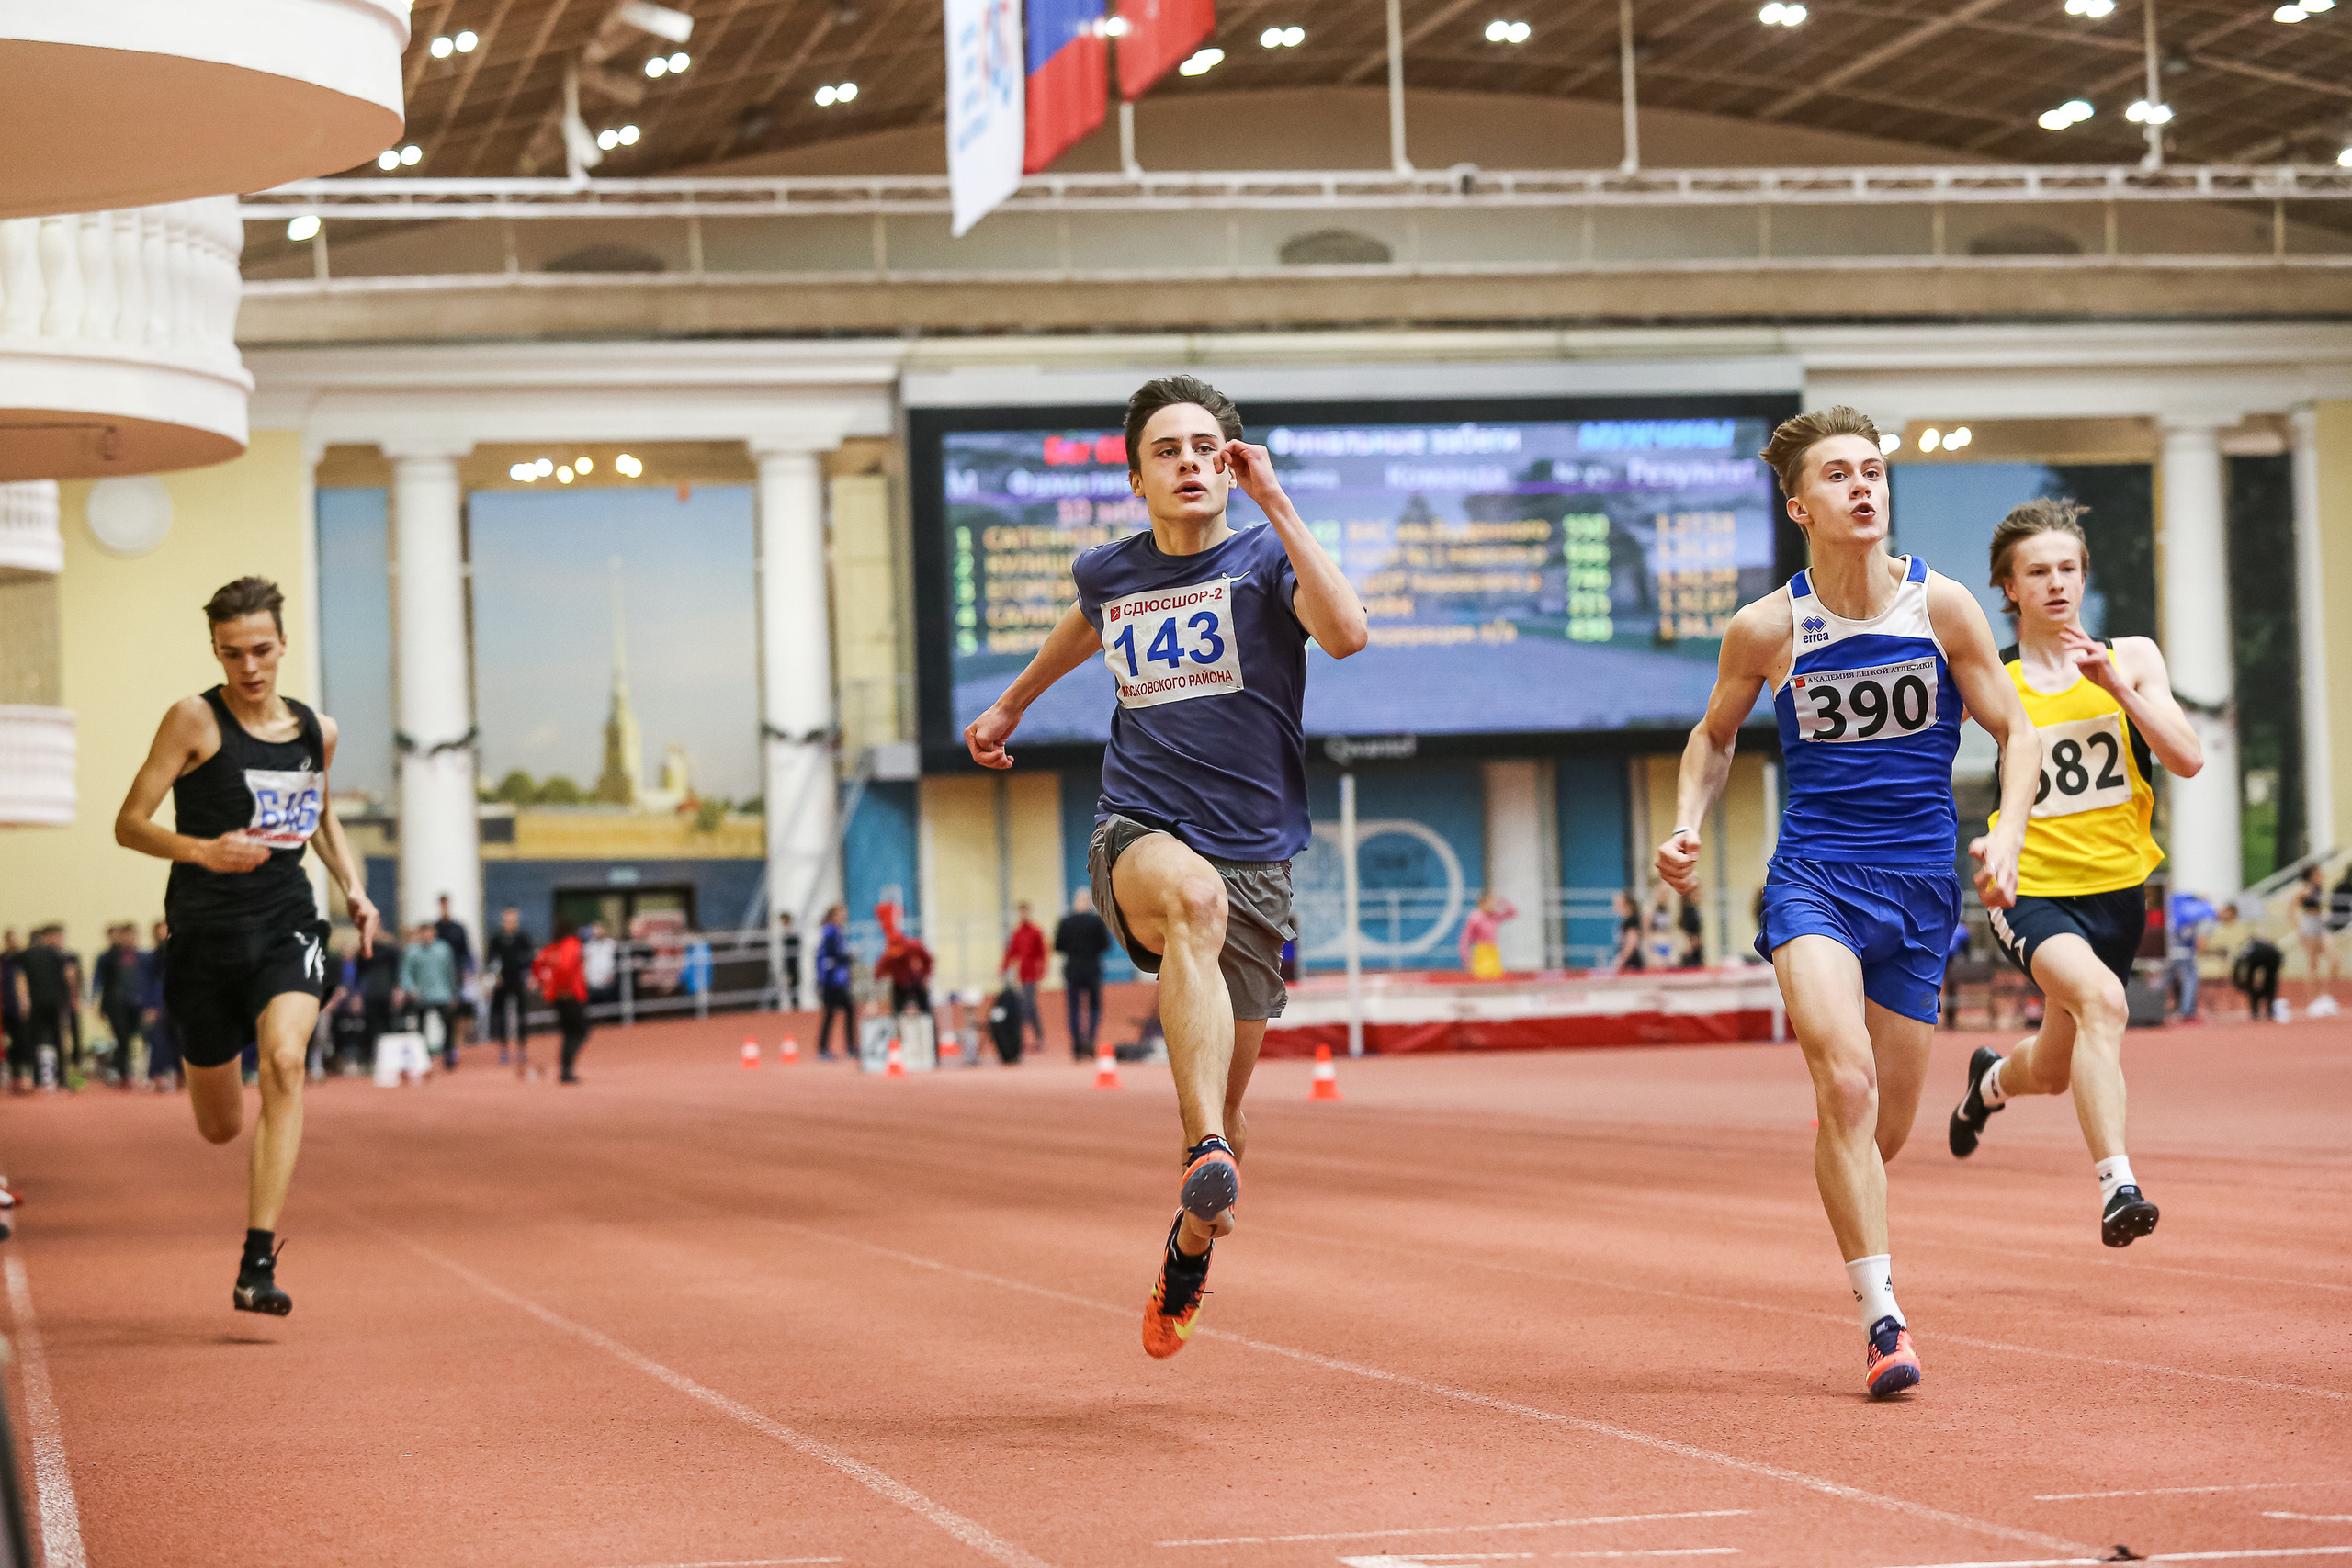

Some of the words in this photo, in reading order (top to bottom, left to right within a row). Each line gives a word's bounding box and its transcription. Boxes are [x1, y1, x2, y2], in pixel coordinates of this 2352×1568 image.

[1123, 587, 1223, 617] СДЮСШОР-2
[1114, 611, 1225, 678] 143
[1803, 630, 1829, 644] errea
[1190, 669, 1234, 687] РАЙОНА
[1807, 671, 1855, 683] АКАДЕМИЯ
[1856, 667, 1890, 678] ЛЕГКОЙ
[1807, 674, 1929, 739] 390
